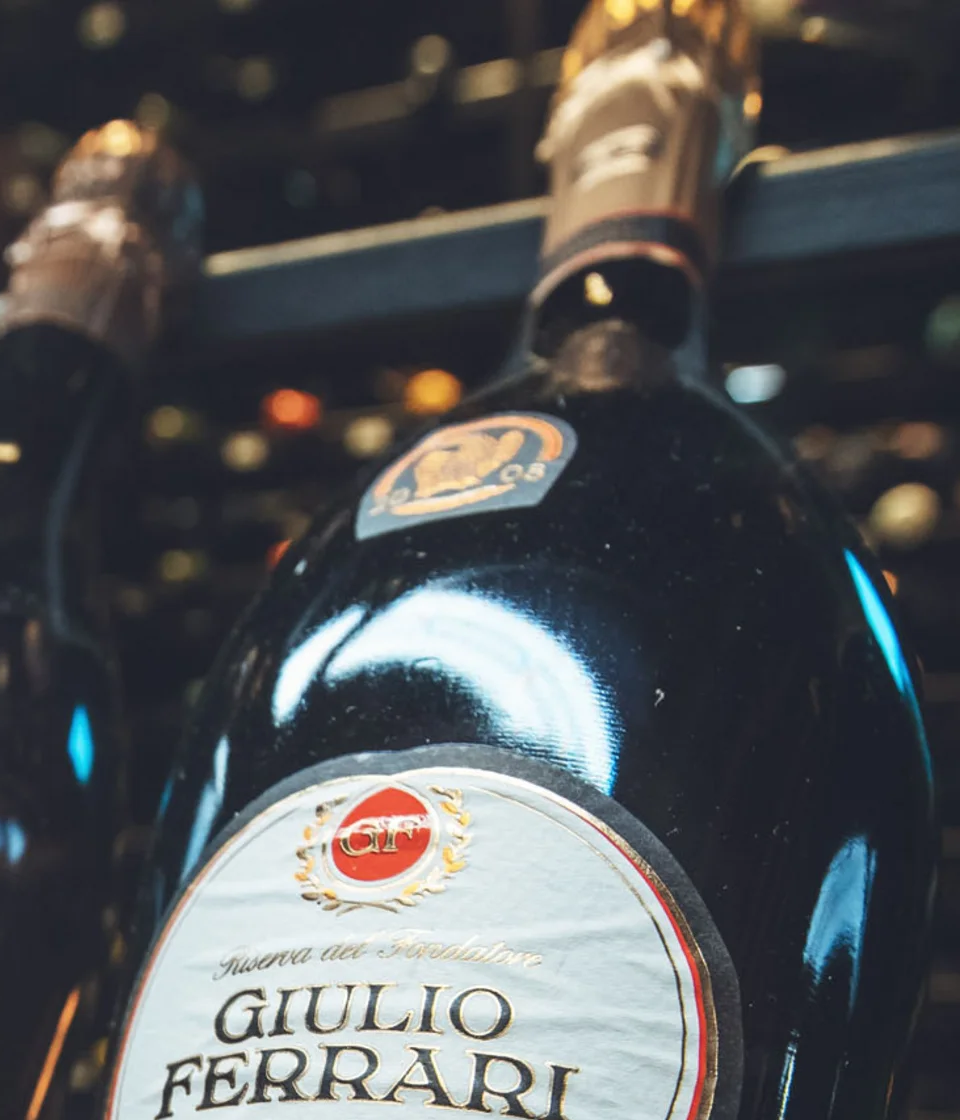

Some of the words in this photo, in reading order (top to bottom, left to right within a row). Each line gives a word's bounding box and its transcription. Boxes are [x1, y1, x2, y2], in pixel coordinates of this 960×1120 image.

[339, 818, 421, 858] GF
[212, 944, 313, 981] Riserva
[320, 935, 378, 962] del
[377, 928, 543, 969] Fondatore
[213, 981, 516, 1045] GIULIO
